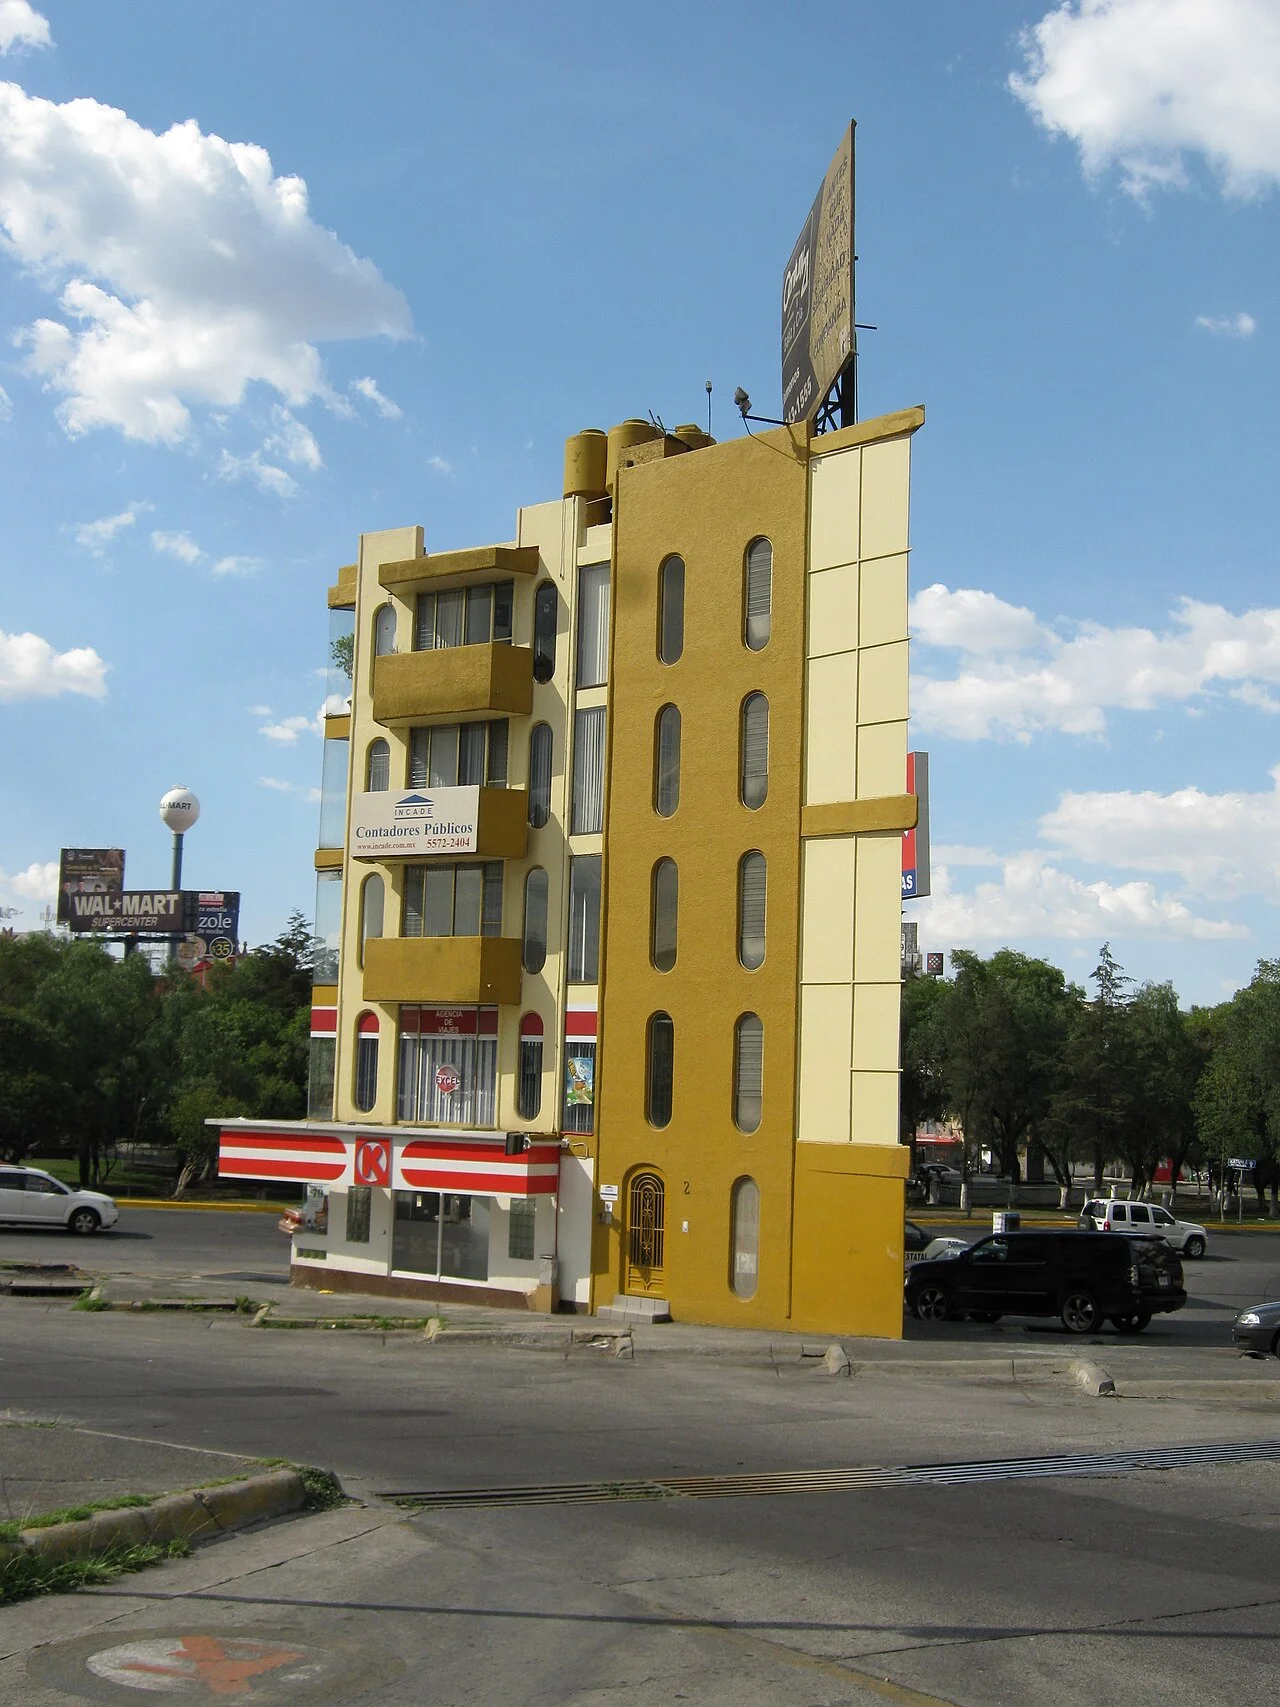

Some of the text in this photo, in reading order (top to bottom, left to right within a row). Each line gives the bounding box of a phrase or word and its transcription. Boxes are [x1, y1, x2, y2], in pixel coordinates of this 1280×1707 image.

[394, 808, 433, 816] INCADE
[356, 822, 473, 839] Contadores Públicos
[357, 837, 471, 850] www.incade.com.mx 5572-2404
[91, 916, 158, 927] SUPERCENTER
[436, 1010, 463, 1018] AGENCIA
[438, 1026, 459, 1034] VIAJES
[435, 1076, 460, 1085] EXCEL
[361, 1144, 386, 1180] K
[684, 1181, 690, 1194] 2
